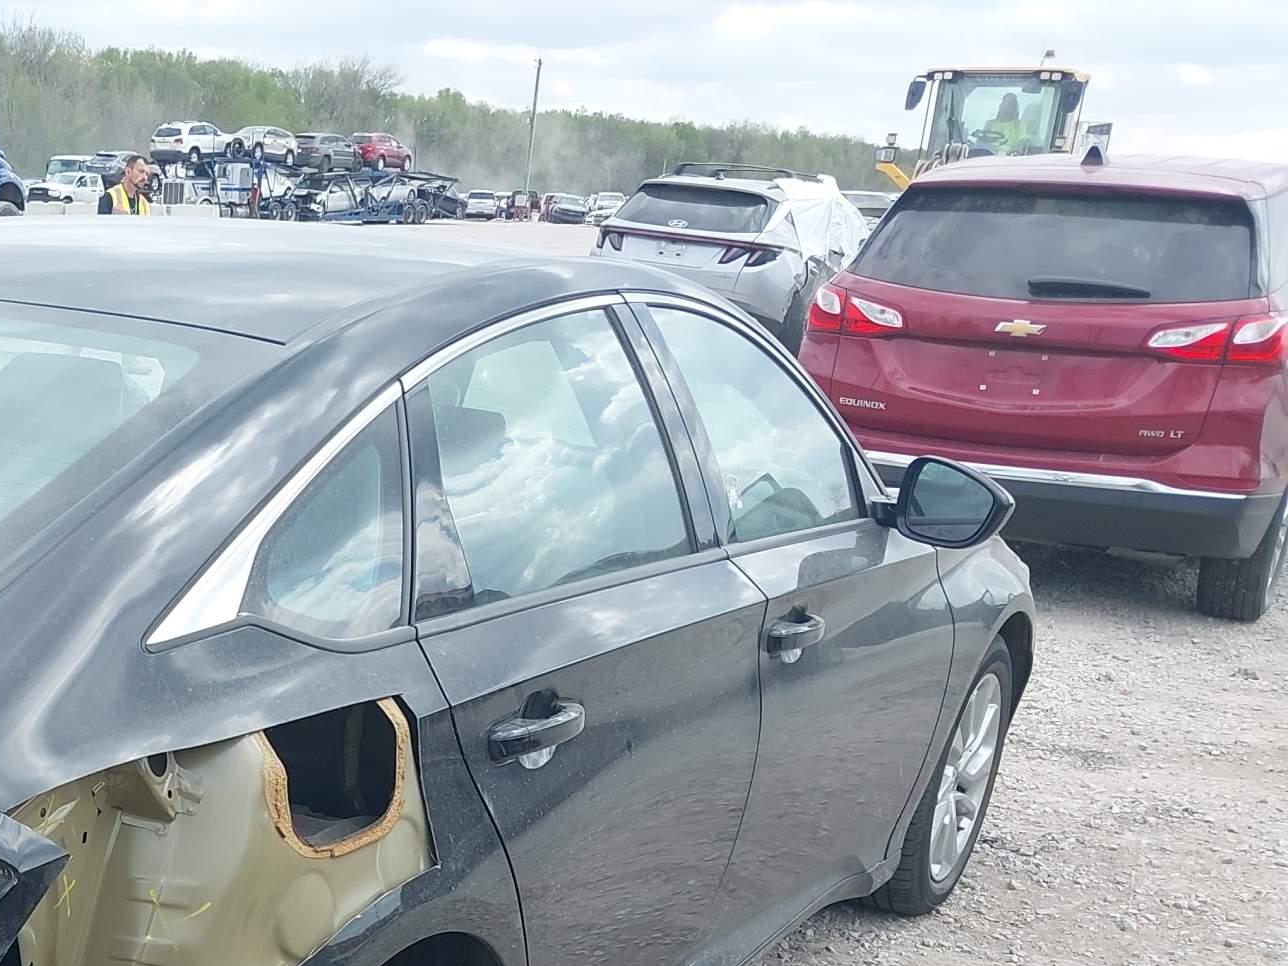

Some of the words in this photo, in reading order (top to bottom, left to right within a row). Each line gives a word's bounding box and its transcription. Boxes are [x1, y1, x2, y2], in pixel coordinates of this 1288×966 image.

[839, 396, 887, 410] EQUINOX
[1138, 429, 1165, 438] AWD
[1170, 430, 1185, 439] LT
